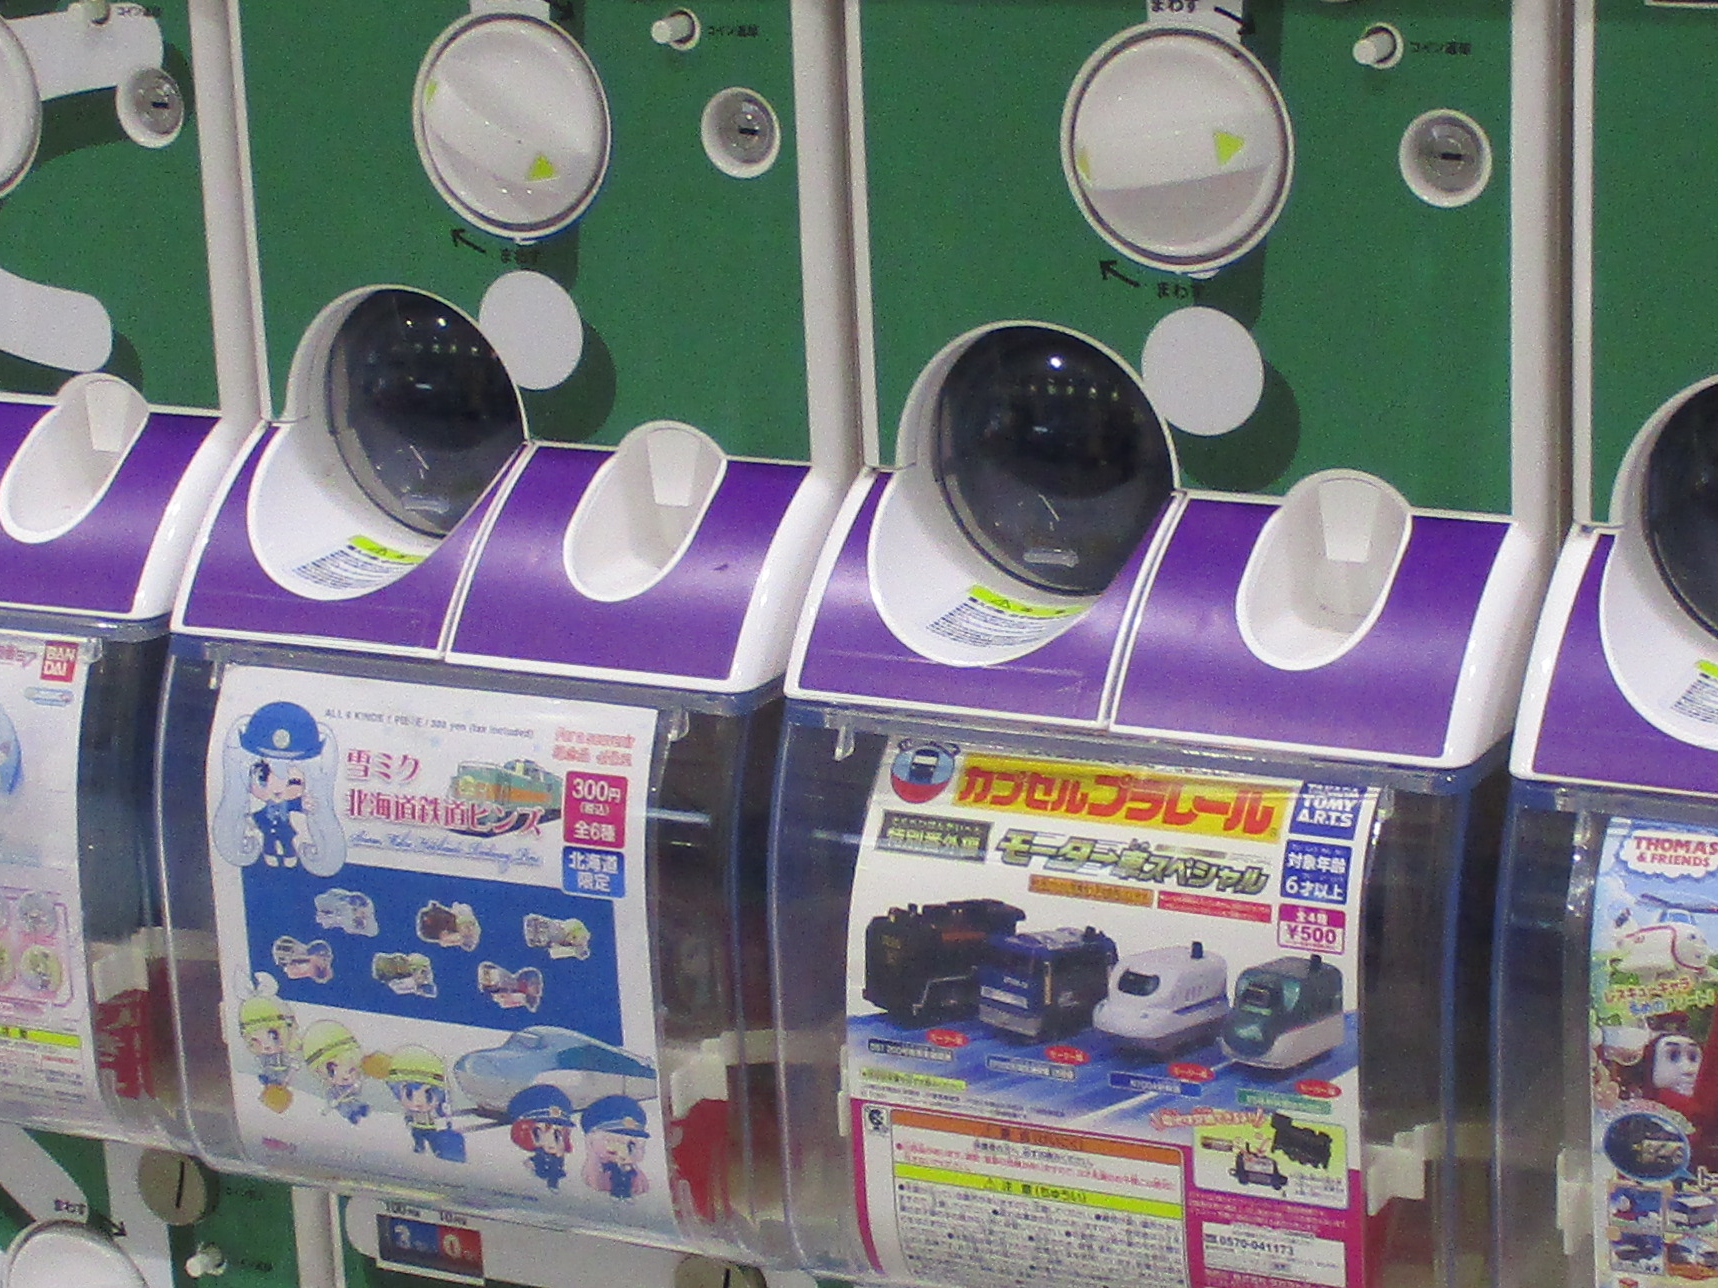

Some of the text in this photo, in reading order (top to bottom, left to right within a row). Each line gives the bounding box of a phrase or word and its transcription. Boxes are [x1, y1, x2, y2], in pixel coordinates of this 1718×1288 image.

[46, 644, 78, 661] BAN
[43, 660, 67, 677] DAI
[346, 748, 422, 782] 雪ミク
[572, 777, 621, 802] 300円
[958, 766, 1276, 835] カプセルプラレール
[345, 787, 545, 837] 北海道鉄道ピンズ
[1302, 793, 1359, 812] TOMY
[573, 822, 617, 842] 全6種
[568, 850, 619, 874] 北海道
[996, 829, 1271, 895] モーター車スペシャル
[1287, 851, 1347, 875] 対象年齢
[1650, 852, 1711, 868] FRIENDS
[576, 872, 612, 892] 限定
[1284, 875, 1345, 901] 6才以上
[1285, 925, 1338, 946] ¥500
[1218, 1234, 1295, 1255] 0570-041173
